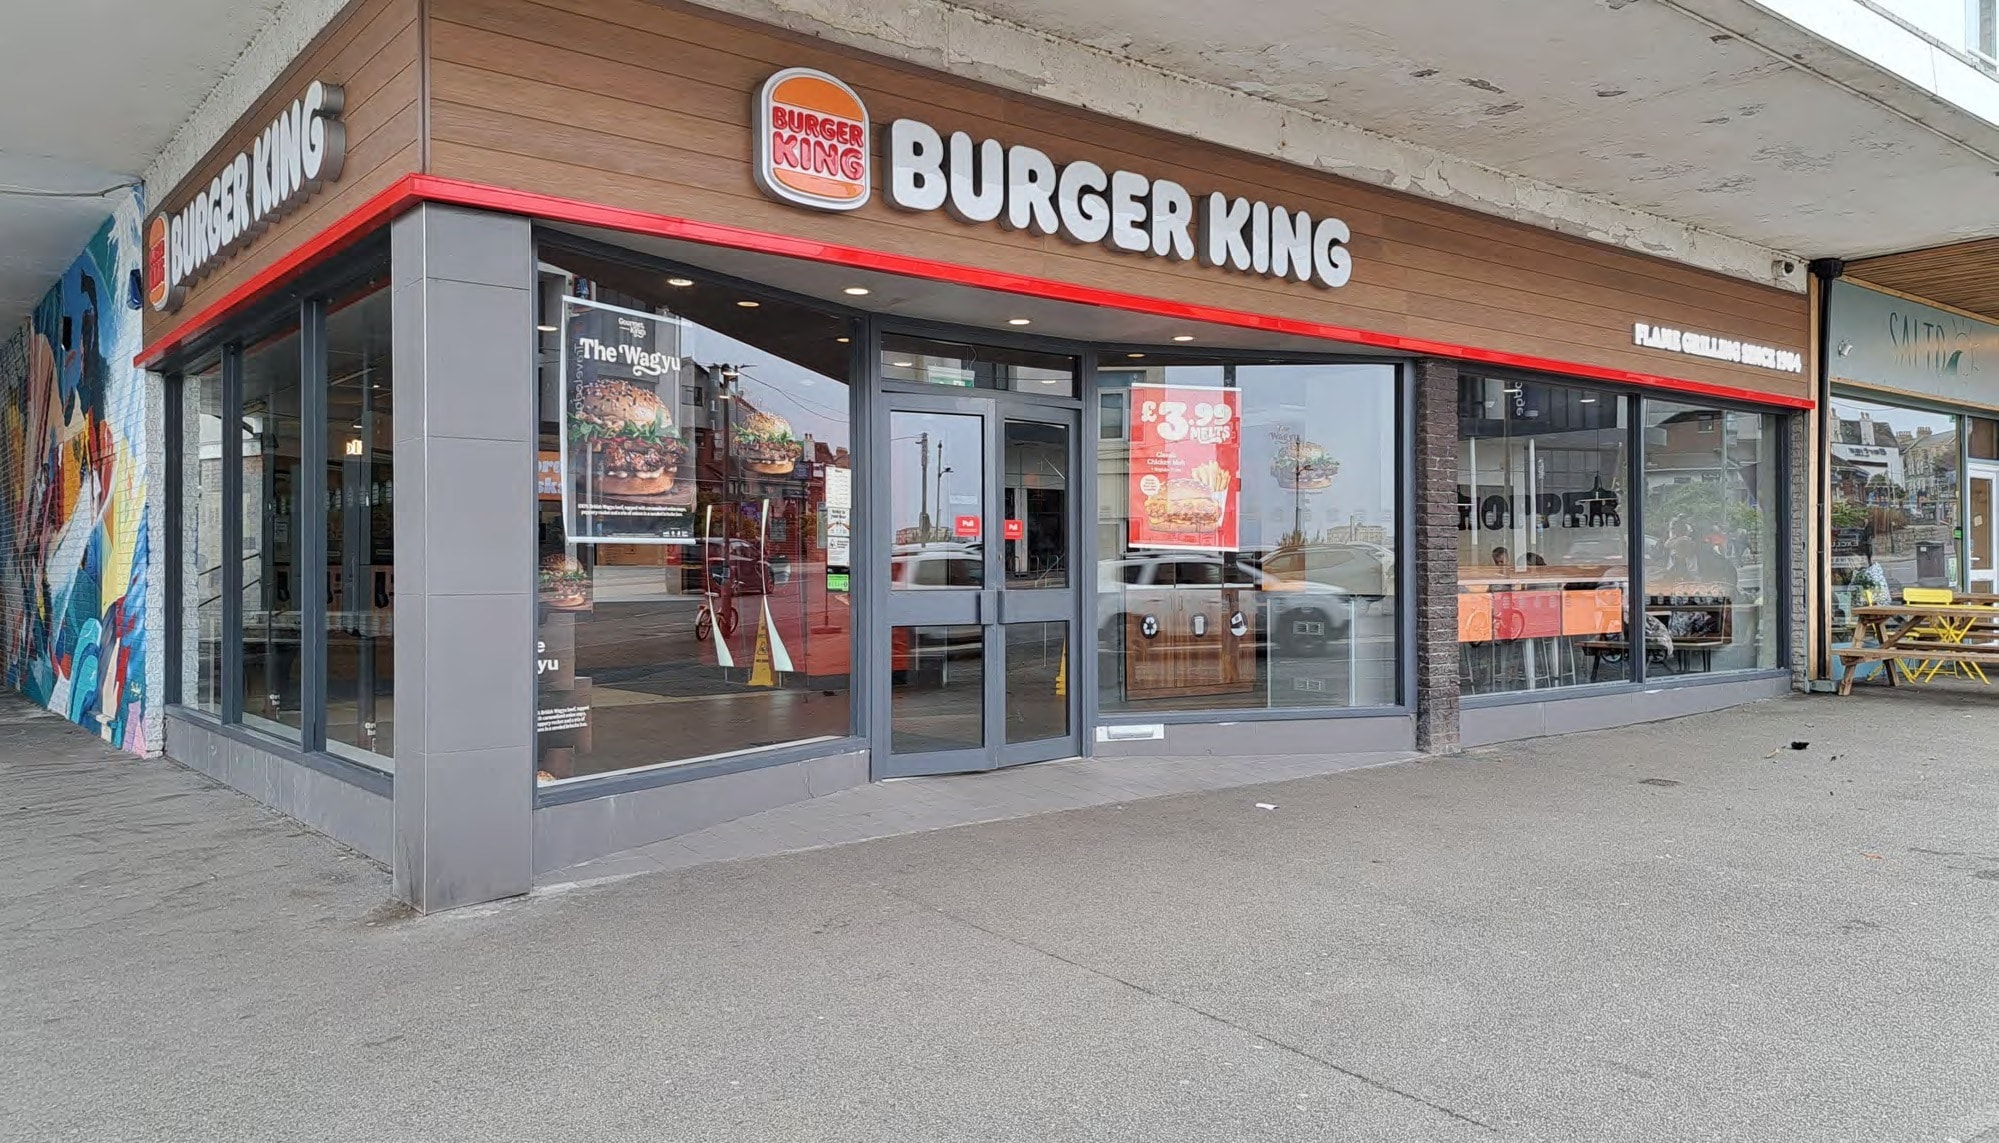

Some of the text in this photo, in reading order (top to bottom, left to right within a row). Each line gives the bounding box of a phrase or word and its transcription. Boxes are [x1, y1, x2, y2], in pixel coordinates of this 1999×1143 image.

[772, 106, 864, 148] BURGER
[772, 132, 864, 180] KING
[171, 80, 325, 286] BURGER KING
[890, 118, 1353, 288] BURGER KING
[579, 338, 681, 376] The Wagyu
[1141, 401, 1232, 441] £3.99
[1189, 425, 1231, 444] MELTS
